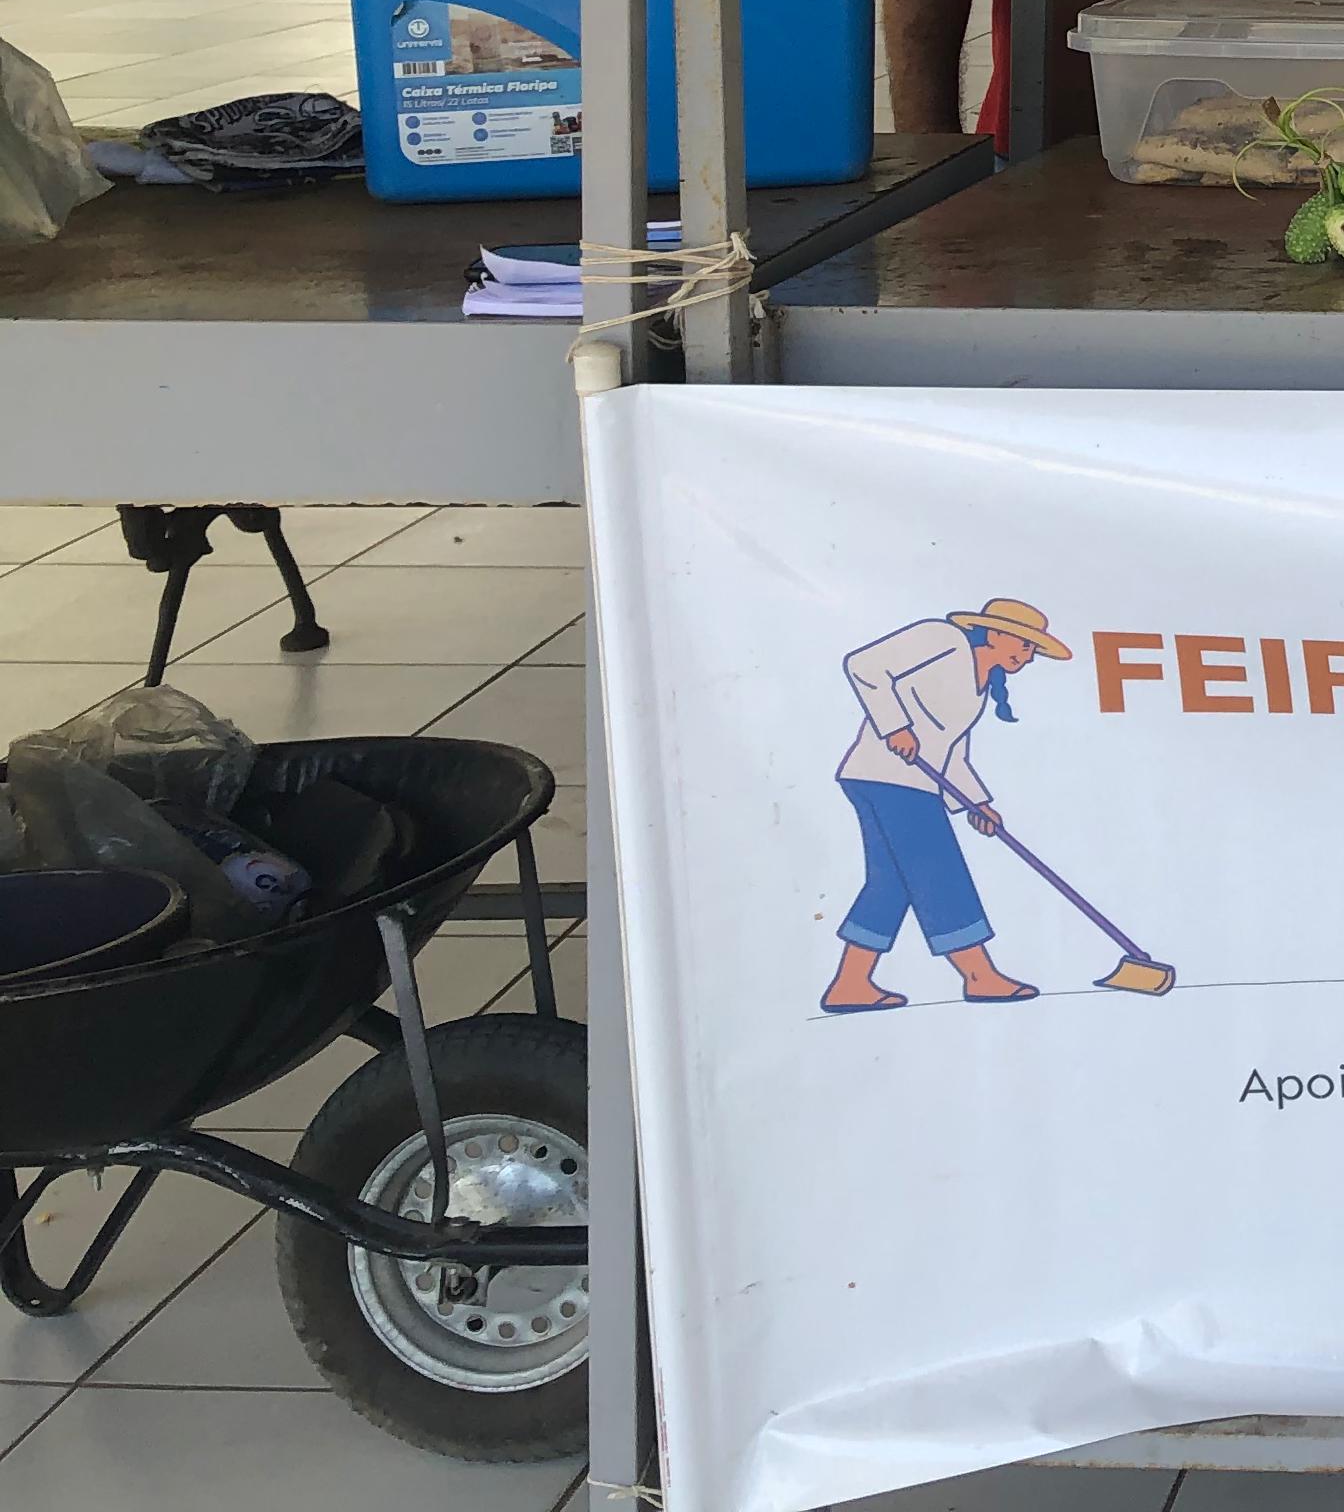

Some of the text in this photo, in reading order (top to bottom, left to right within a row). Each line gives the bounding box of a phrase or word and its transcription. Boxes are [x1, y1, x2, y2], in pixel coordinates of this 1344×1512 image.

[402, 80, 558, 98] Caixa Térmica Floripa
[447, 98, 459, 106] 22
[461, 96, 489, 105] Latas
